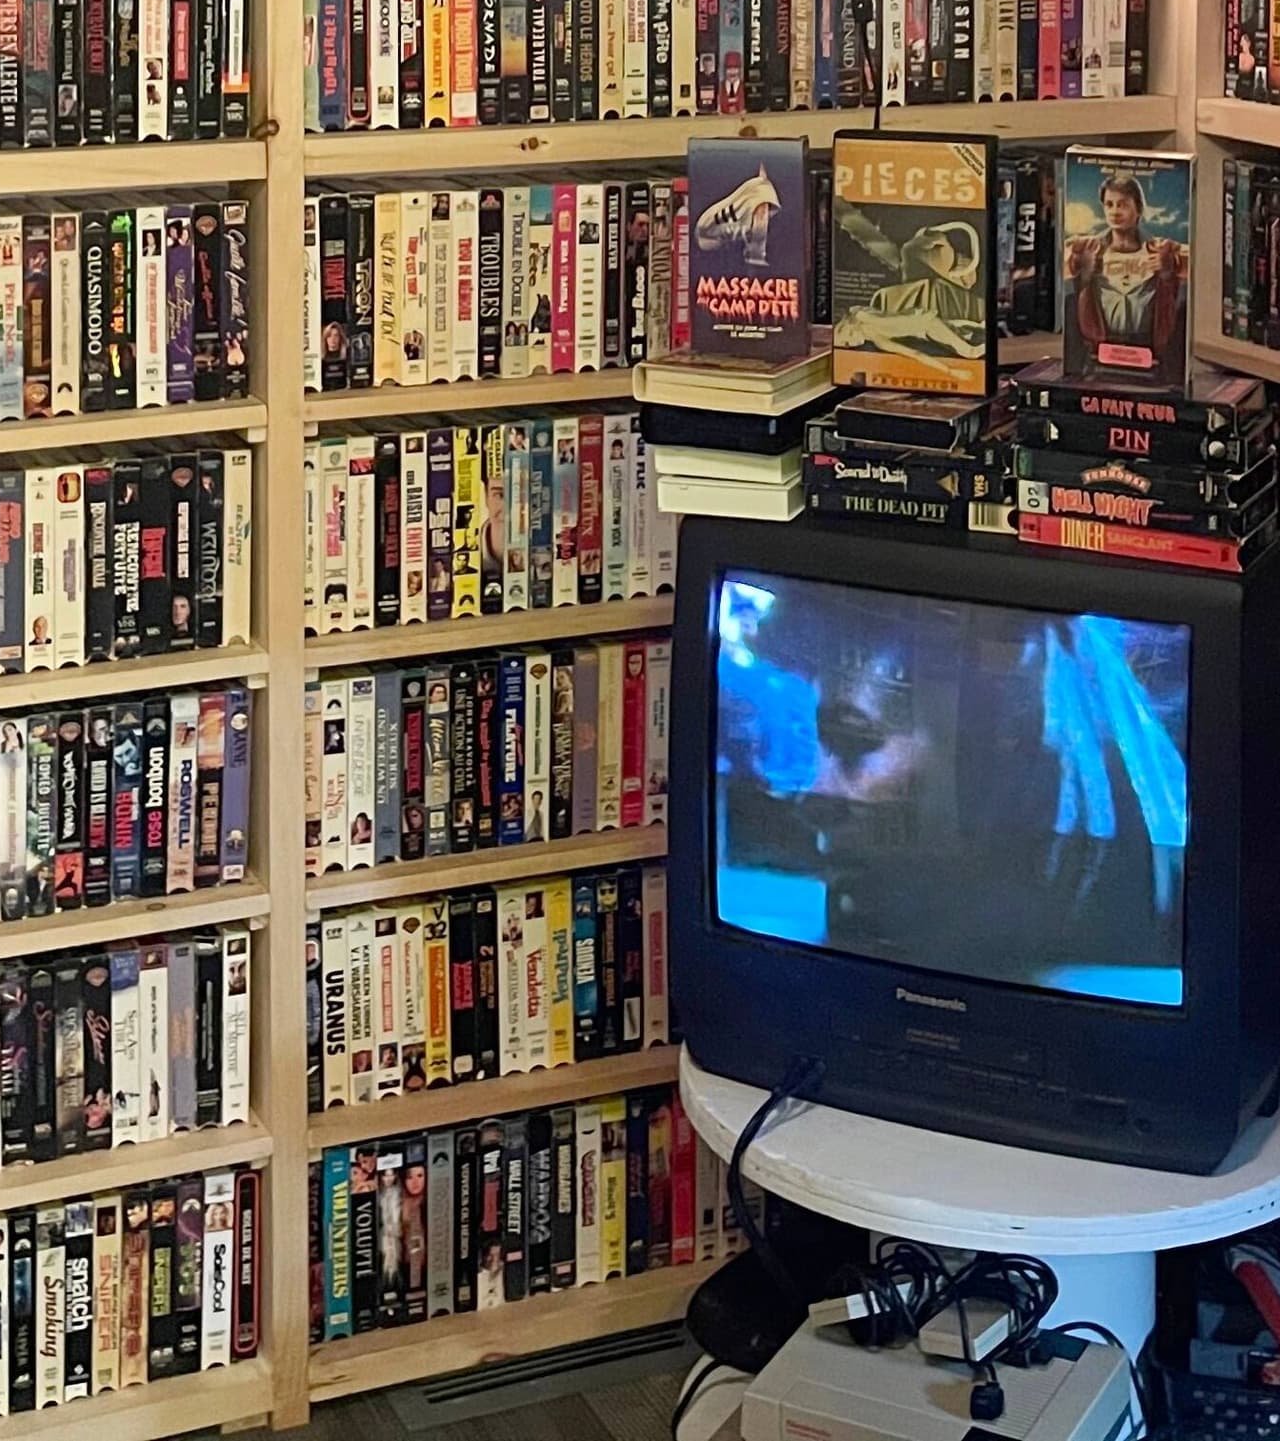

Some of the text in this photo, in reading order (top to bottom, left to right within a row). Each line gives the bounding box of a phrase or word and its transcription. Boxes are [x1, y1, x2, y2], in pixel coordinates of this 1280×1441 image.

[889, 22, 900, 48] ans
[835, 162, 976, 202] PIECES
[512, 214, 524, 257] TROUBLE
[1019, 202, 1037, 253] U-571
[86, 246, 100, 355] QUASIMODO
[480, 231, 500, 319] TROUBLES
[512, 275, 524, 316] DOUBLE
[697, 275, 798, 298] MASSACRE
[1102, 398, 1132, 419] FAIT
[1109, 427, 1151, 454] PIN
[842, 495, 948, 521] THE DEAD PIT
[1052, 485, 1096, 515] HELL
[114, 524, 125, 596] FORTUITE
[126, 521, 139, 612] RENCONTRE
[146, 748, 164, 847] rose bonbon
[177, 759, 192, 847] ROSWELL
[324, 969, 346, 1056] URANUS
[350, 967, 359, 1040] WARSHAWSKI
[362, 944, 370, 1038] KATHLEEN TURNER
[526, 949, 540, 1018] Vendetta
[896, 987, 966, 1011] Panasonic
[508, 1160, 521, 1234] WALL STREET
[332, 1182, 349, 1298] VOLUNTEERS
[41, 1276, 64, 1358] Smoking
[71, 1257, 91, 1332] snatch
[98, 1255, 112, 1352] SNIPER
